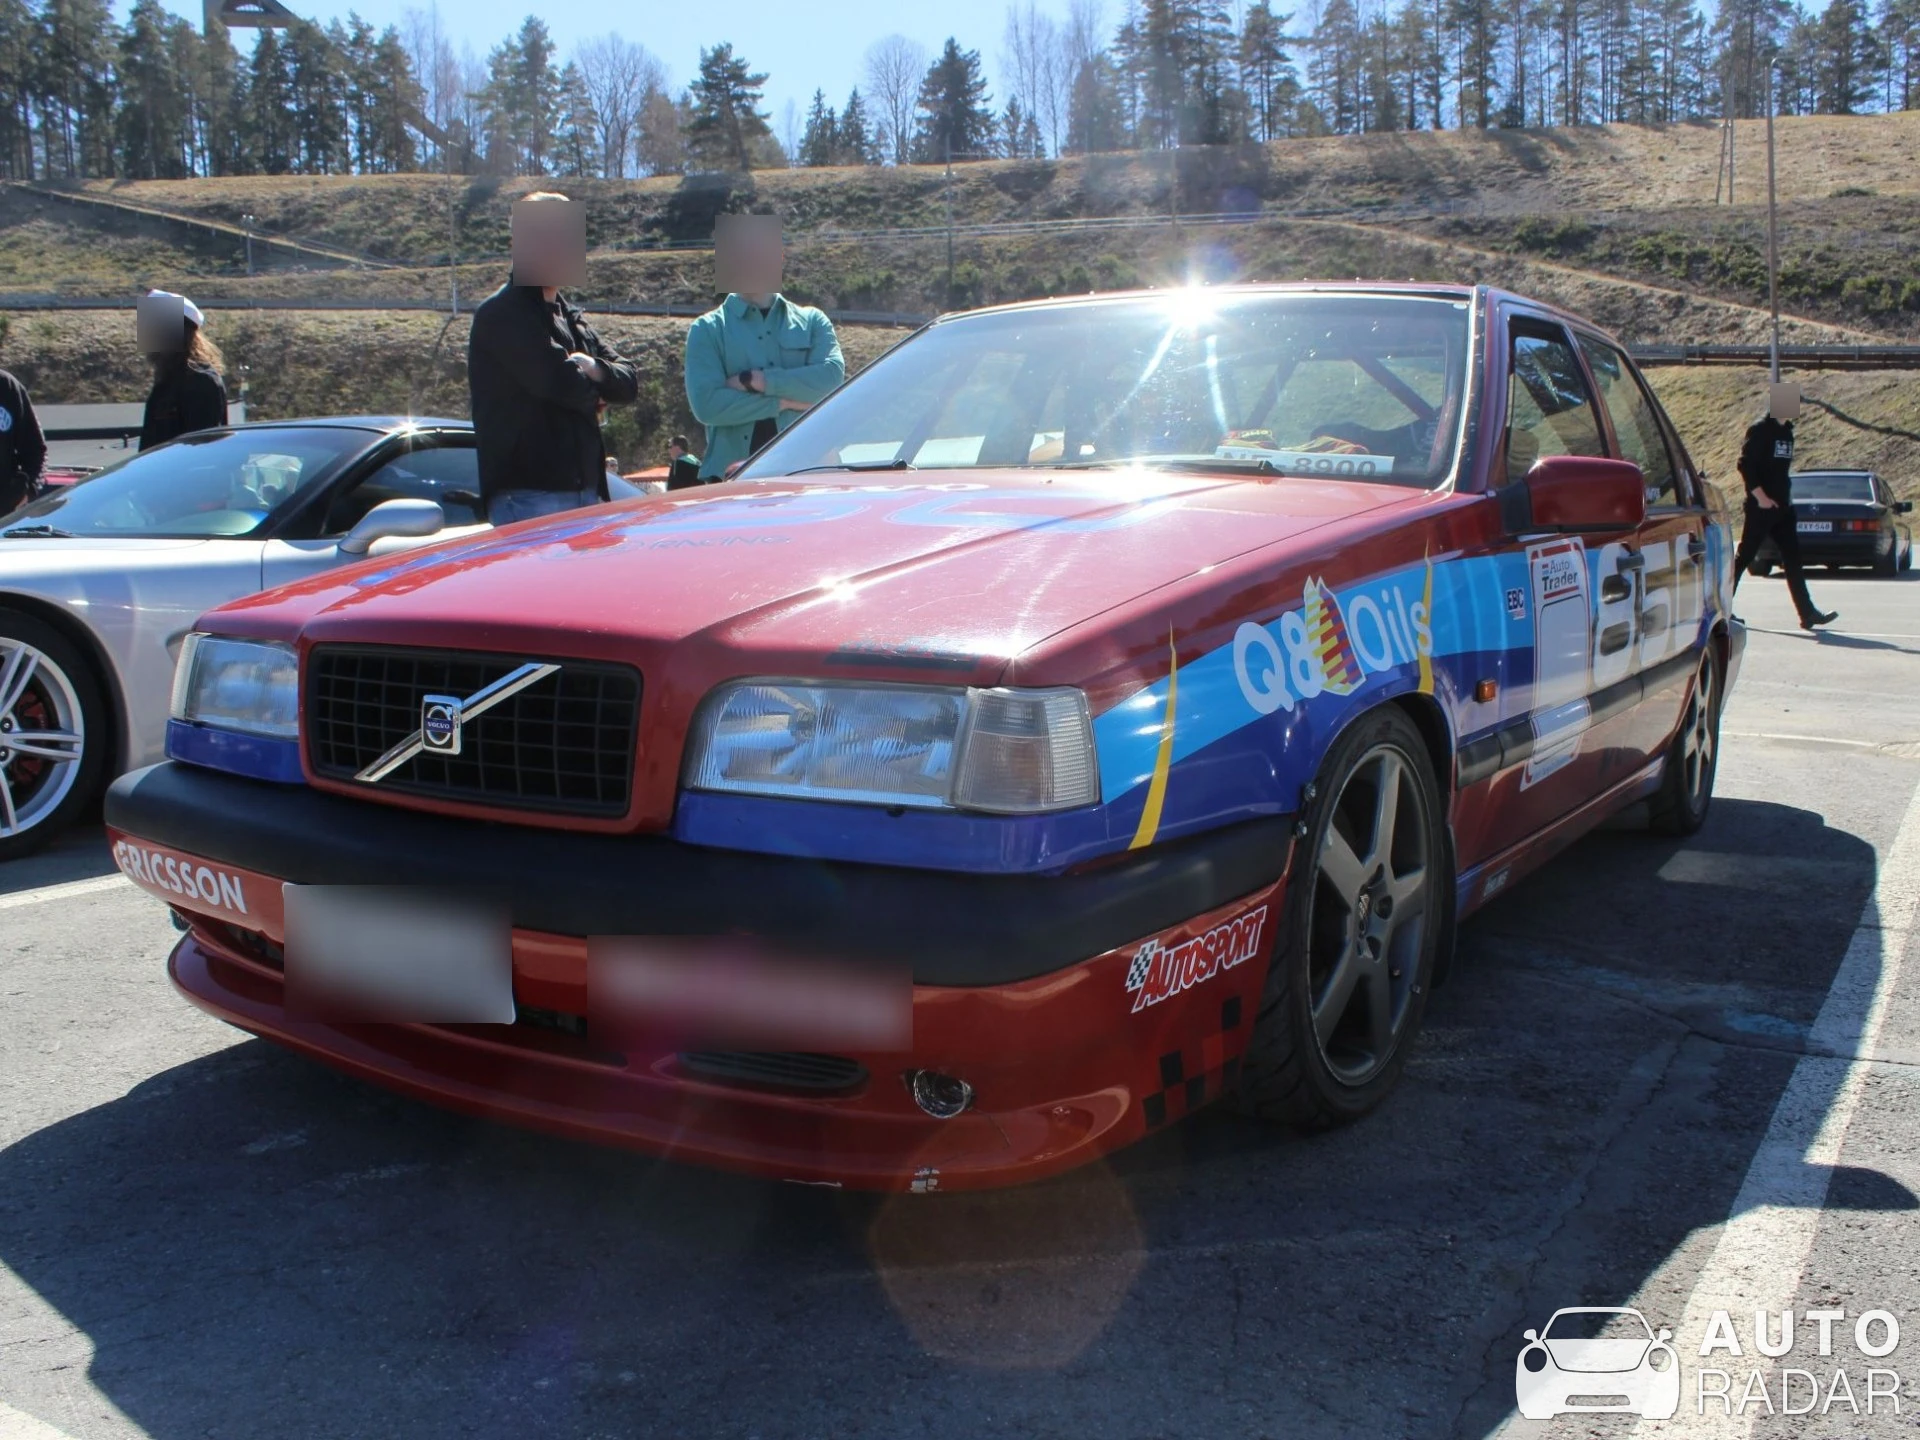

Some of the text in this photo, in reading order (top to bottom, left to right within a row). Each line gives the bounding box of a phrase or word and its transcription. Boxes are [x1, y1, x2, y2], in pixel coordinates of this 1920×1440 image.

[672, 483, 990, 507] VOLVO
[1549, 560, 1571, 575] Auto
[1541, 572, 1578, 592] Trader
[1506, 588, 1524, 610] EBC
[1233, 586, 1433, 715] Q8 Oils
[427, 721, 450, 729] VOLVO
[116, 840, 249, 915] ERICSSON
[1131, 904, 1268, 1014] AUTOSPORT
